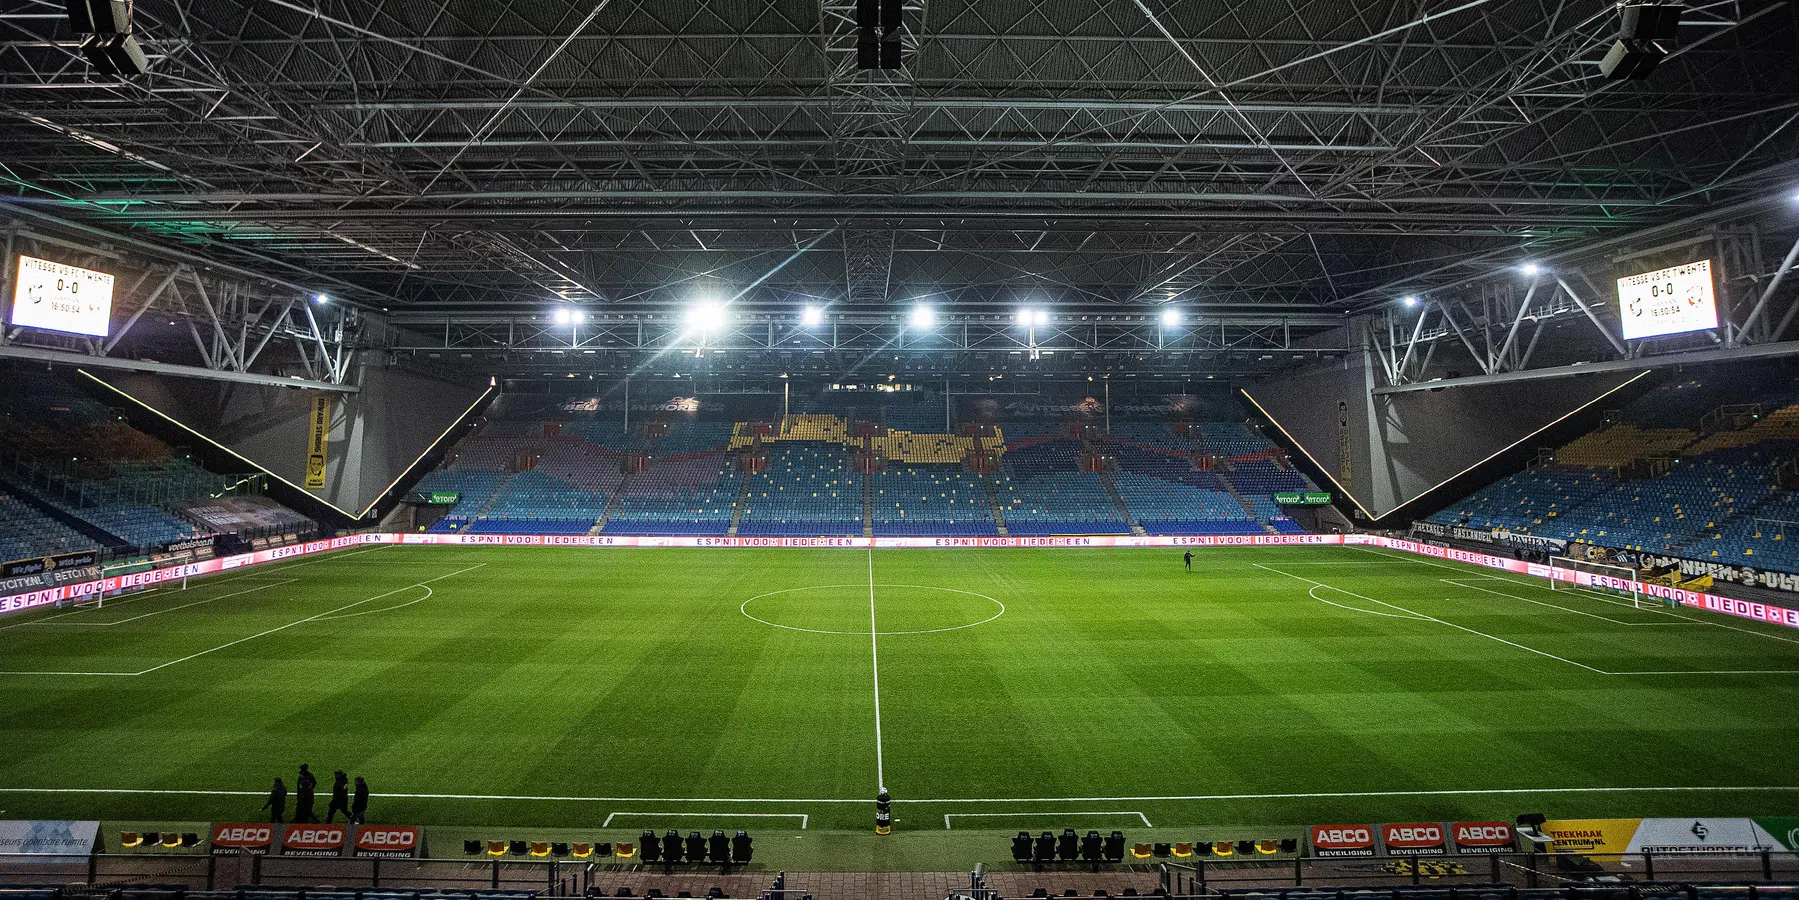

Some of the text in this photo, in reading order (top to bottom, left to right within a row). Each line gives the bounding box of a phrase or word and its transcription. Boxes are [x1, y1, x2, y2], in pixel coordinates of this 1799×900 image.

[24, 258, 56, 273] VITESSE
[1620, 262, 1706, 287] VITESSE VS FC TWENTE
[1651, 305, 1680, 317] 16:50:54
[168, 536, 214, 552] voetbalshop.nl
[508, 536, 540, 544] VOO
[745, 538, 778, 546] VOO
[936, 538, 976, 546] ESPN1
[983, 538, 1016, 546] VOO
[272, 546, 302, 558] ESPN1
[307, 541, 330, 552] VOO
[1390, 540, 1416, 550] ESPN1
[1420, 545, 1444, 555] VOO
[1659, 556, 1734, 582] ANHEM
[0, 576, 44, 592] TCITY.NL
[0, 588, 62, 610] ESPN1
[73, 580, 116, 596] VOO
[1650, 585, 1698, 604] VOO
[216, 828, 270, 842] ABCO
[288, 830, 342, 844] ABCO
[360, 831, 414, 845] ABCO
[1316, 829, 1370, 843] ABCO
[1388, 828, 1440, 842] ABCO
[1458, 826, 1509, 840] ABCO
[1550, 830, 1603, 838] TREKHAAK
[22, 836, 59, 848] openbare
[60, 836, 88, 846] ruimte
